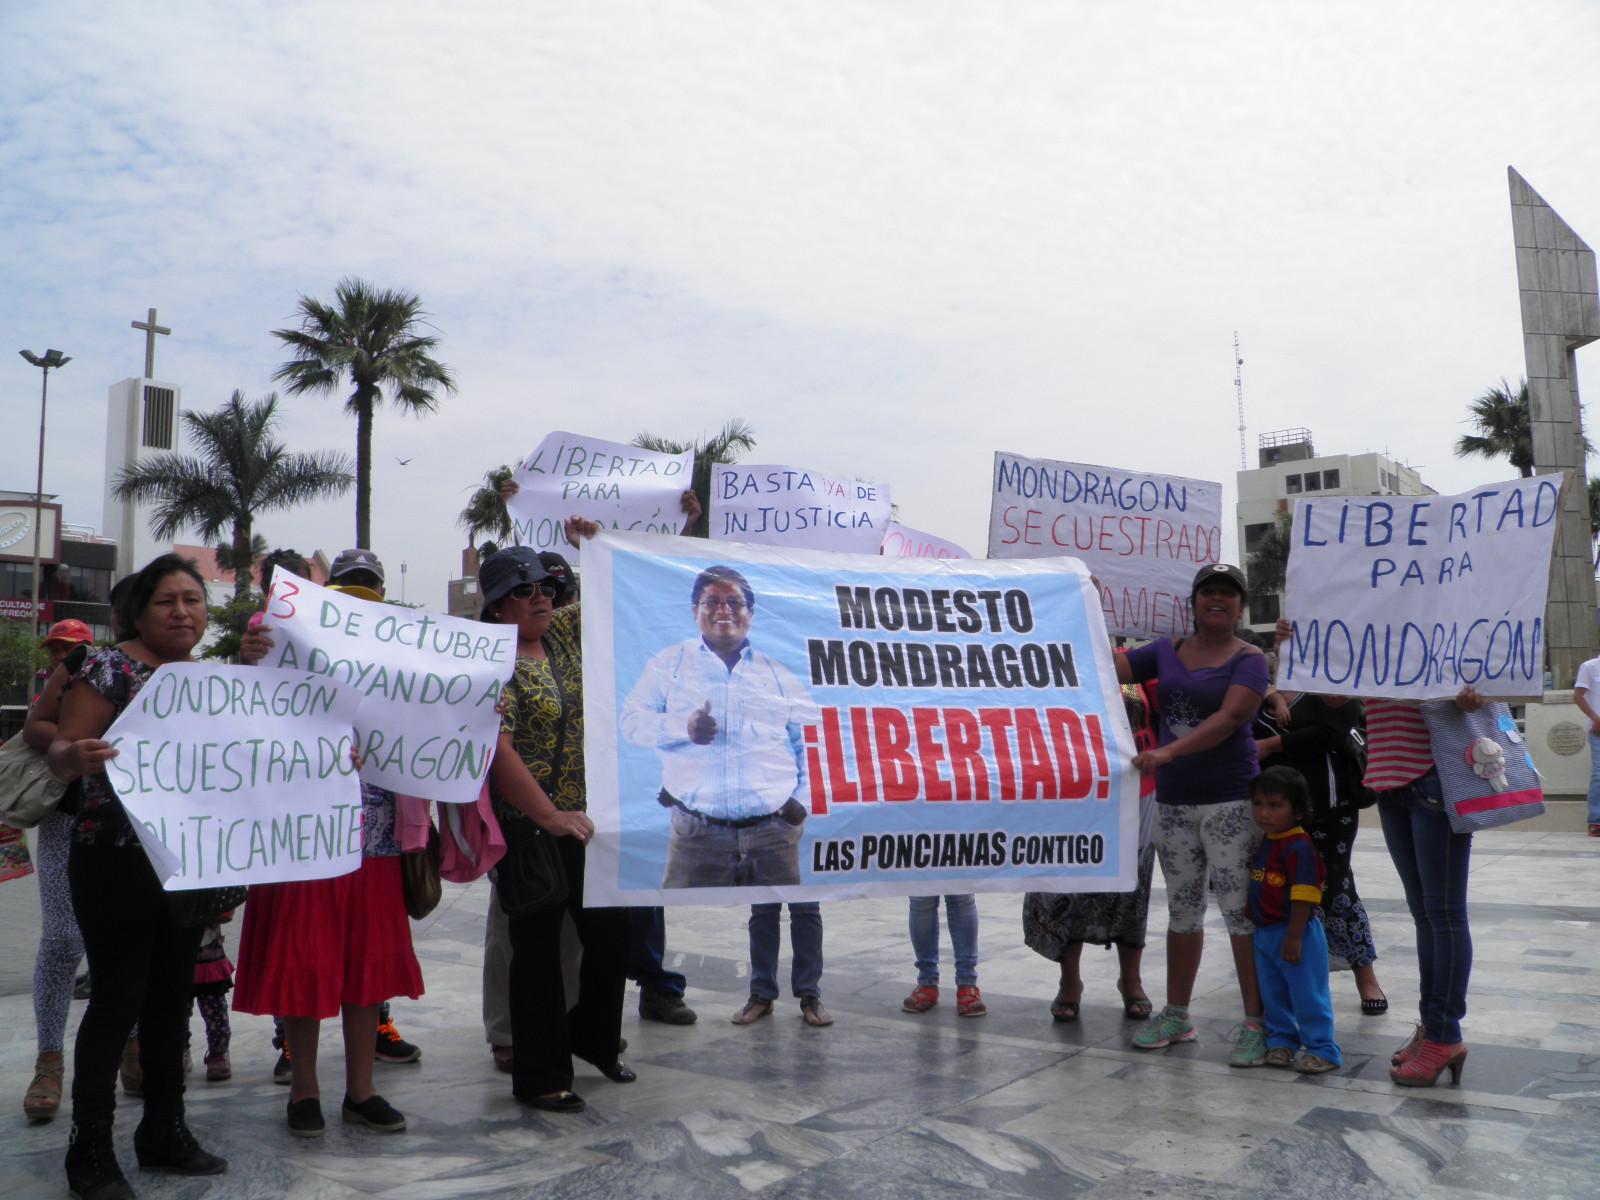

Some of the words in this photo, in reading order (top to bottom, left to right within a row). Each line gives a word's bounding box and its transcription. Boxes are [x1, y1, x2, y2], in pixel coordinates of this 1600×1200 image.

[561, 481, 621, 500] PARA
[857, 486, 877, 501] DE
[997, 459, 1187, 512] MONDRAGON
[1001, 506, 1222, 564] SECUESTRADO
[1371, 551, 1474, 588] PARA
[320, 600, 363, 637] DE
[375, 615, 511, 663] OCTUBRE
[834, 585, 1033, 634] MODESTO
[807, 639, 1079, 688] MONDRAGON
[1286, 610, 1542, 689] MONDRAGÓN
[142, 672, 338, 719] ONDRAGÓN
[475, 679, 501, 707] A
[110, 735, 357, 795] SECUESTRADO
[803, 706, 1110, 815] ¡LIBERTAD!
[813, 840, 855, 872] LAS
[860, 832, 1007, 870] PONCIANAS
[1011, 833, 1104, 865] CONTIGO
